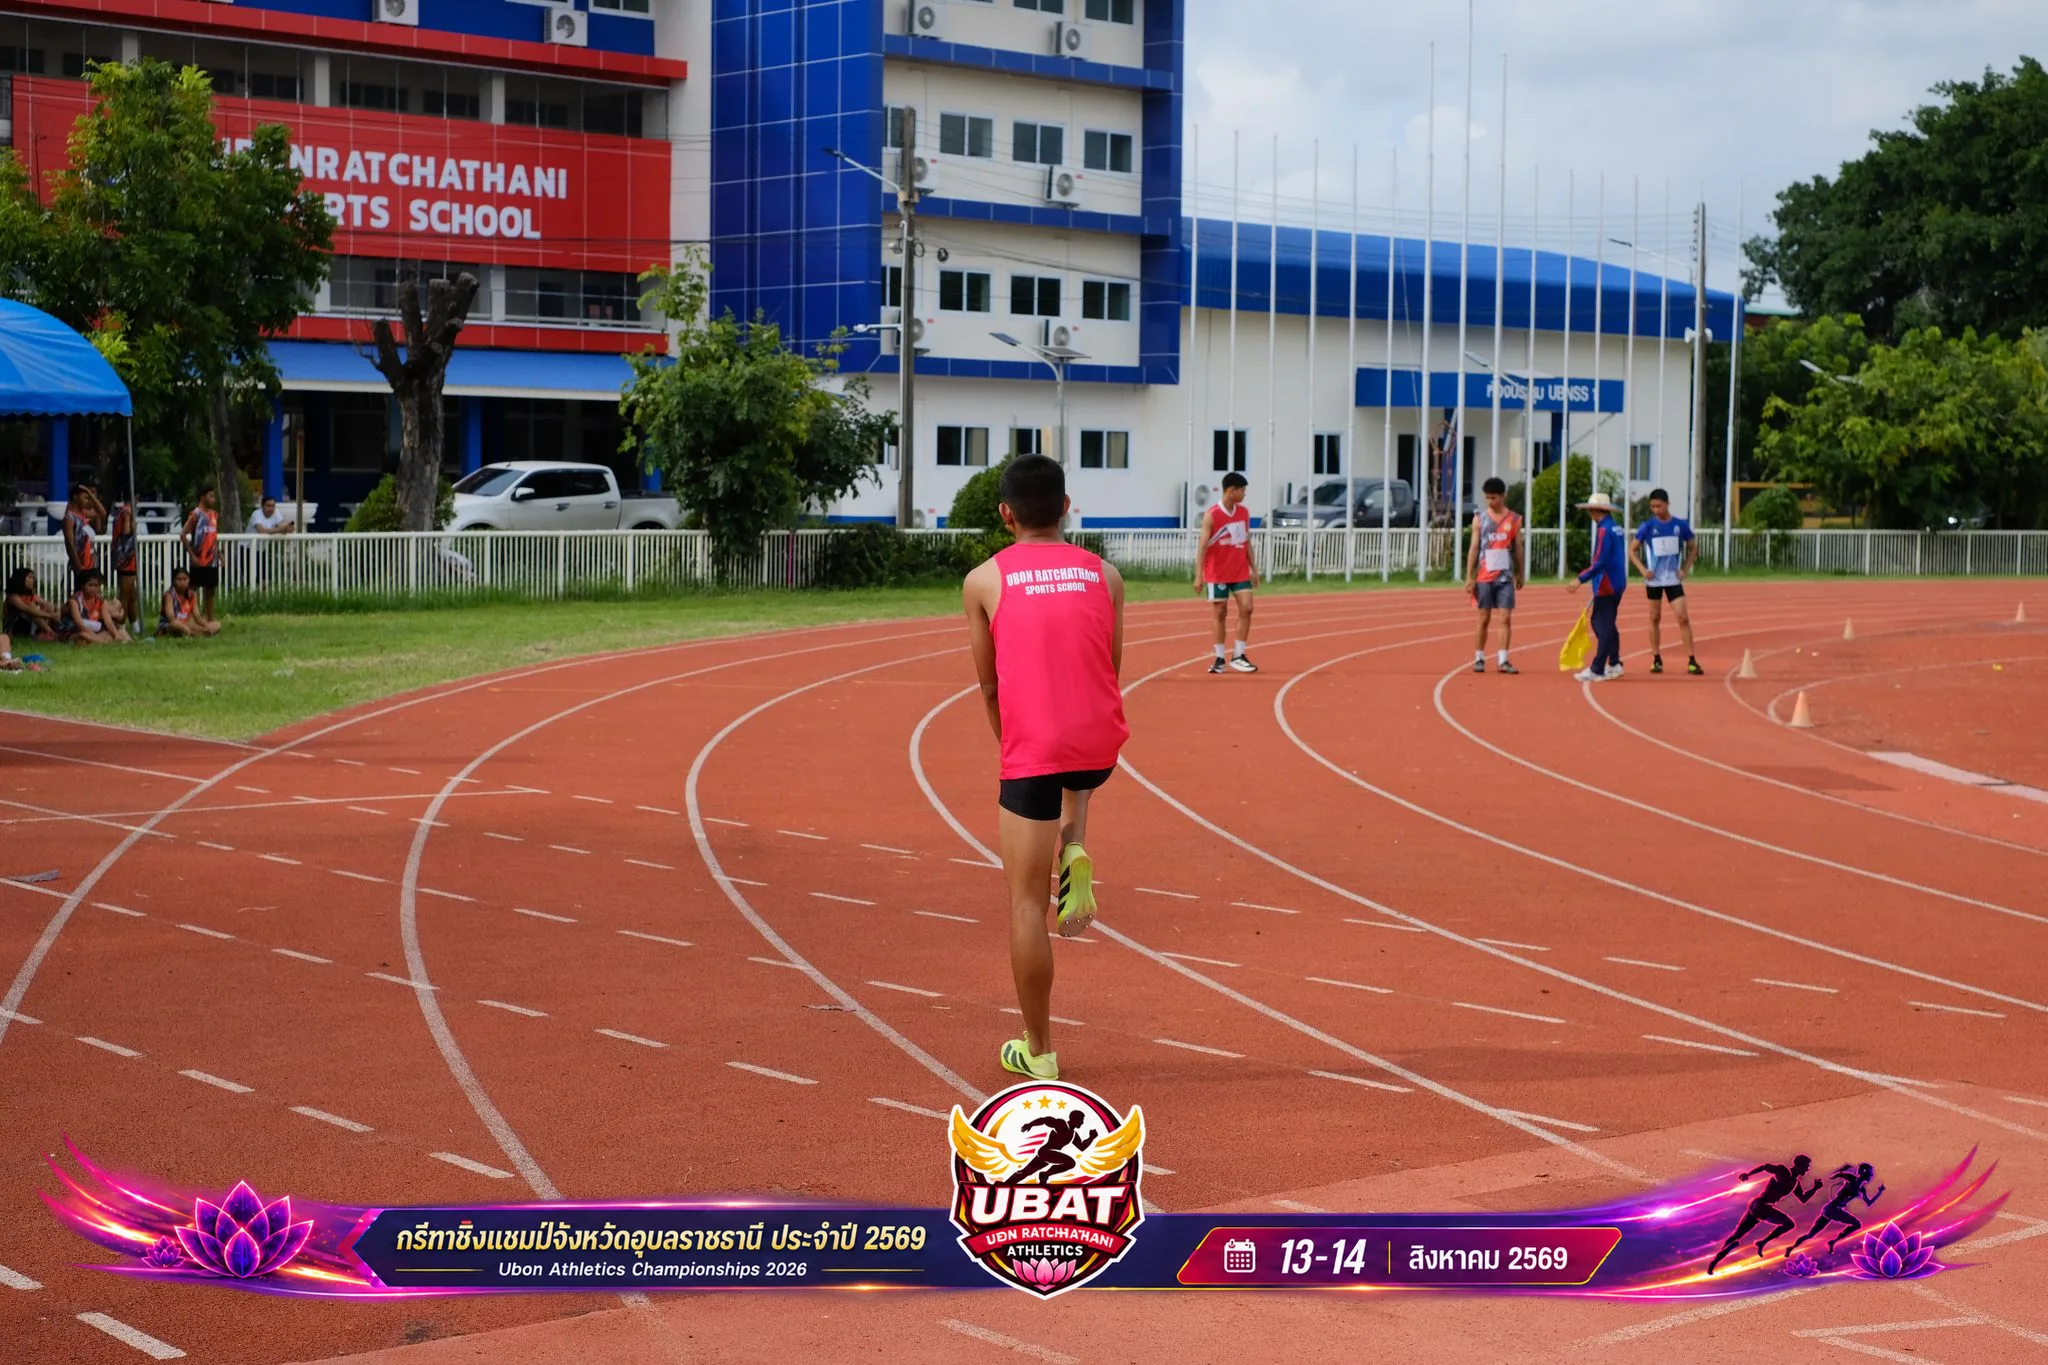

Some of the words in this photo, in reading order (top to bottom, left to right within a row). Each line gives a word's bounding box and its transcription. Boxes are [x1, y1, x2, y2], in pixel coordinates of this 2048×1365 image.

[409, 198, 542, 239] SCHOOL
[1005, 569, 1033, 587] UBON
[1034, 567, 1100, 583] RATCHATHANI
[1024, 583, 1055, 596] SPORTS
[1057, 581, 1086, 593] SCHOOL
